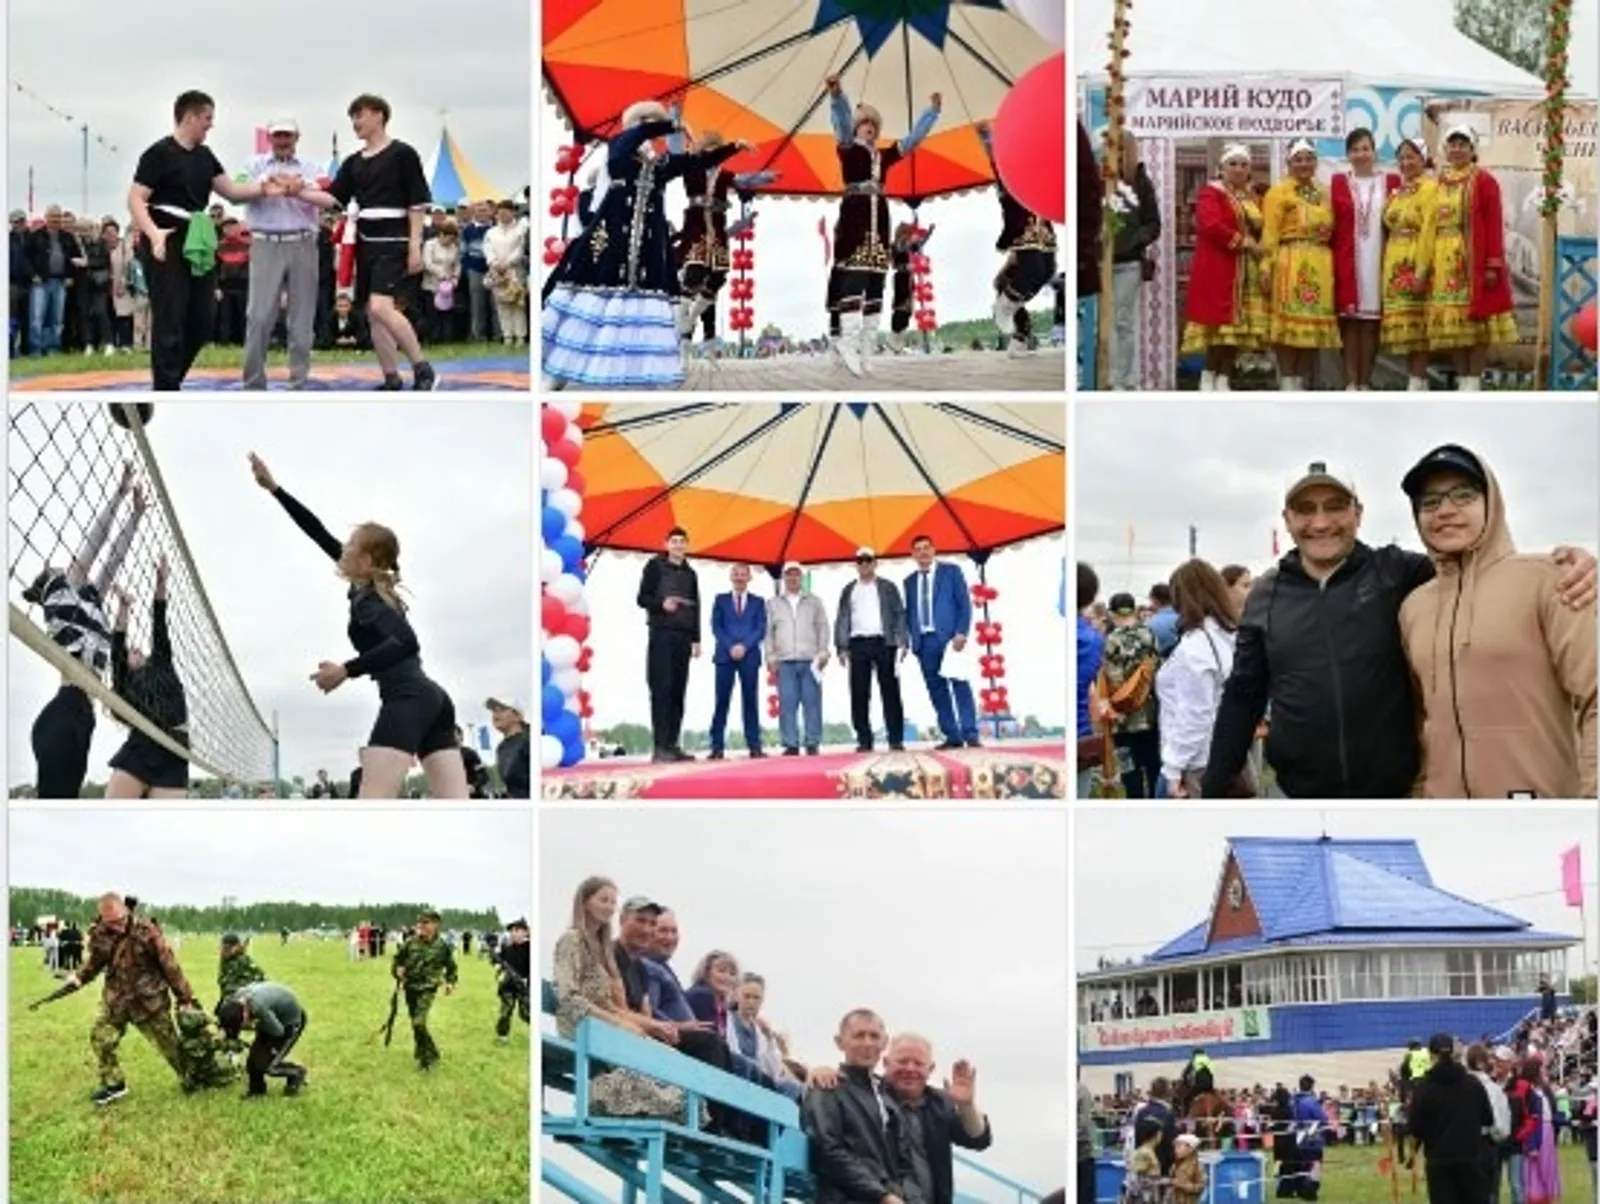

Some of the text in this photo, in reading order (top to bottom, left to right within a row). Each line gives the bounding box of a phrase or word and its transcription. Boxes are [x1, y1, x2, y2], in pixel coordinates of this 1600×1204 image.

[1146, 83, 1313, 111] МАРИЙ КУДО
[1132, 113, 1234, 132] МАРИЙСКОЕ
